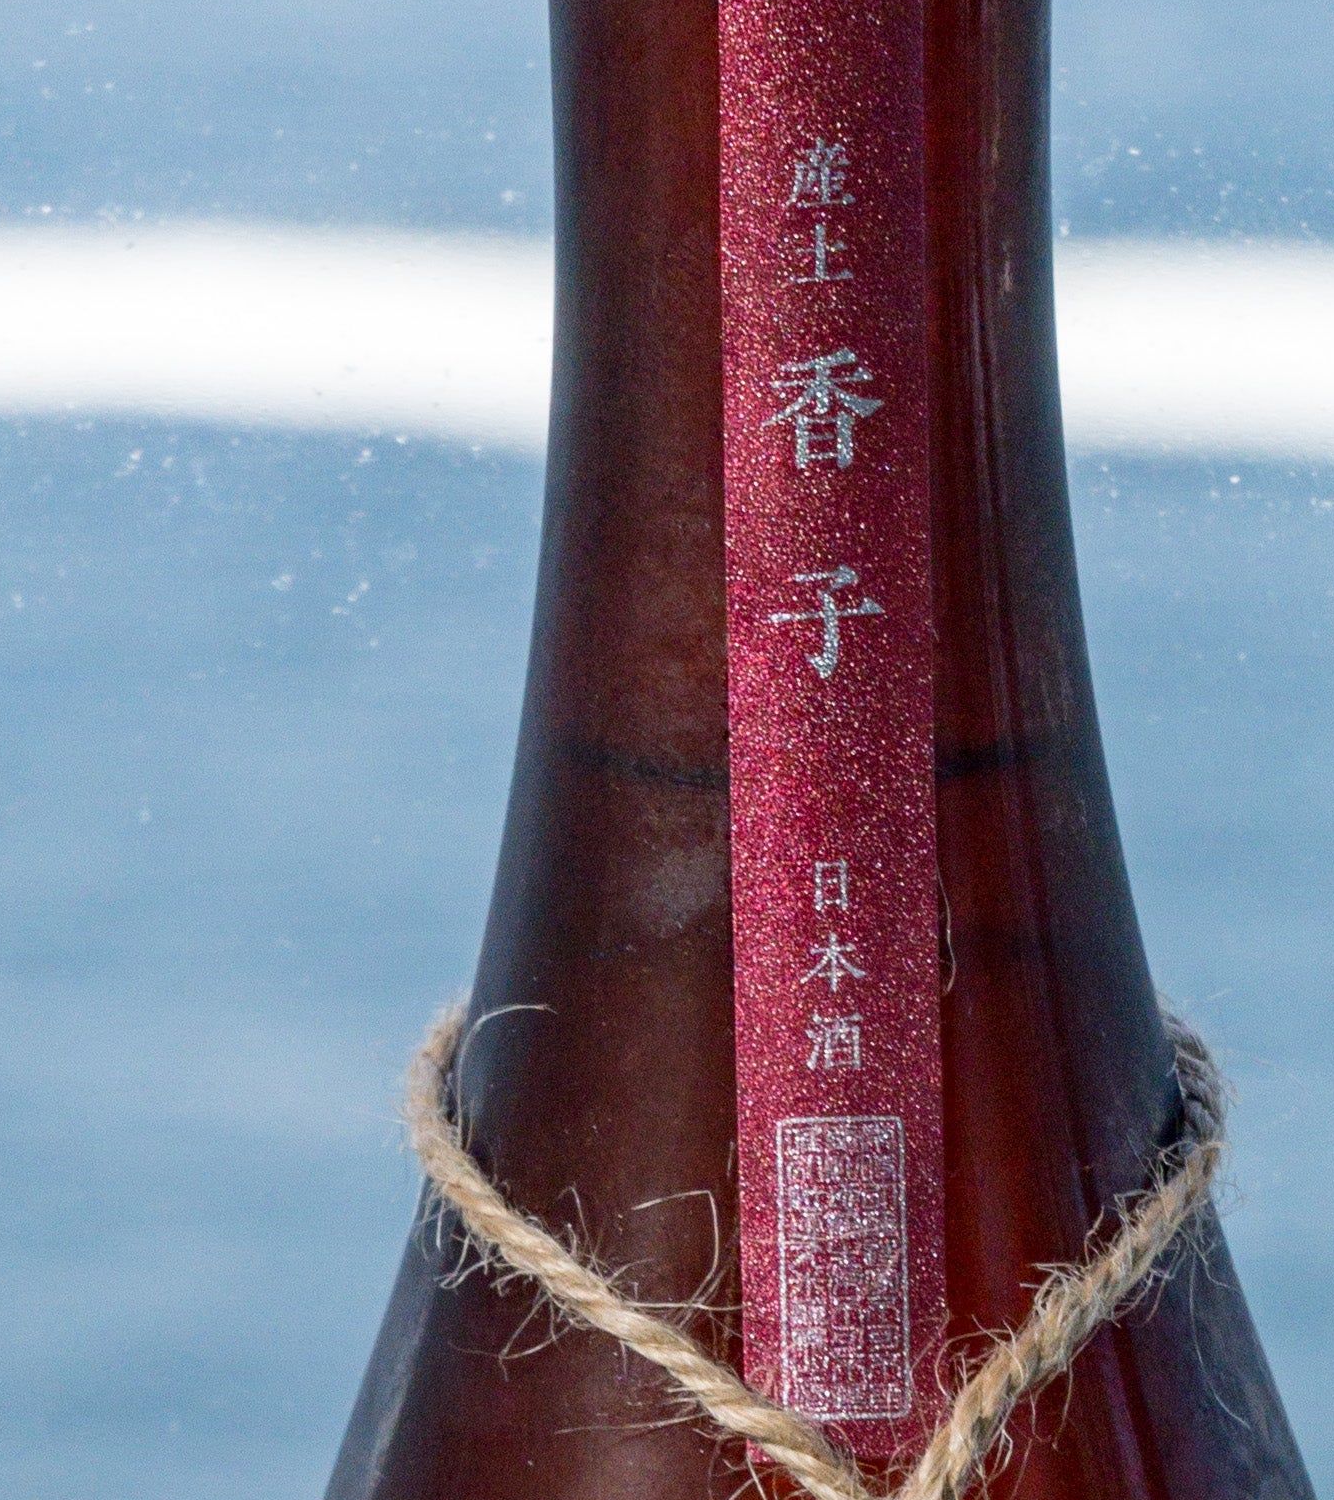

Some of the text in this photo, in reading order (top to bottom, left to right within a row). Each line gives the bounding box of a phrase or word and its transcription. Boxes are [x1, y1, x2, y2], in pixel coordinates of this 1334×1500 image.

[785, 137, 857, 285] 産土
[763, 348, 886, 679] 香子
[800, 858, 866, 1072] 日本酒
